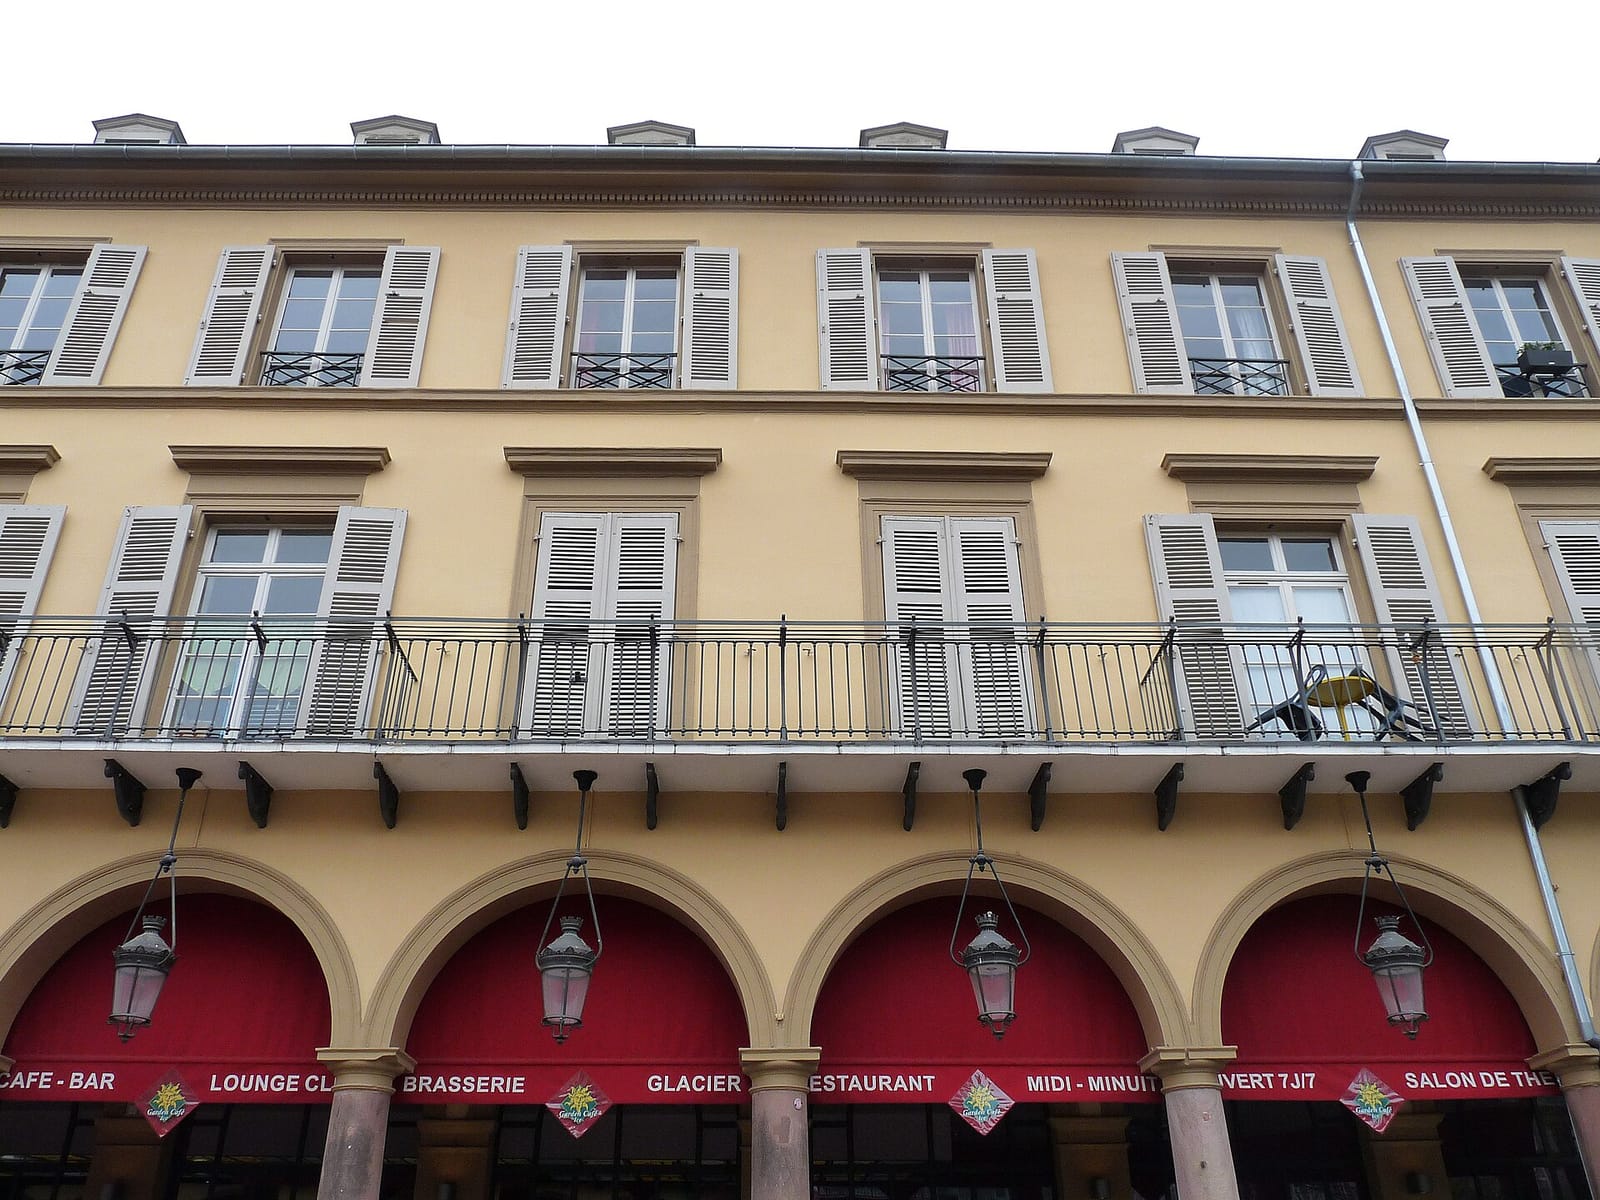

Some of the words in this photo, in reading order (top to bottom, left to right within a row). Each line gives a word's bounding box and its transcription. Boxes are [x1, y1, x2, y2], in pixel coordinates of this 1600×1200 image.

[0, 1071, 53, 1089] CAFE
[69, 1072, 115, 1090] BAR
[209, 1074, 300, 1092] LOUNGE
[304, 1075, 334, 1092] CL
[403, 1076, 526, 1093] BRASSERIE
[647, 1075, 742, 1092] GLACIER
[808, 1075, 936, 1092] ESTAURANT
[1027, 1075, 1072, 1092] MIDI
[1087, 1075, 1157, 1092] MINUIT
[1404, 1071, 1477, 1089] SALON
[1479, 1071, 1510, 1088] DE
